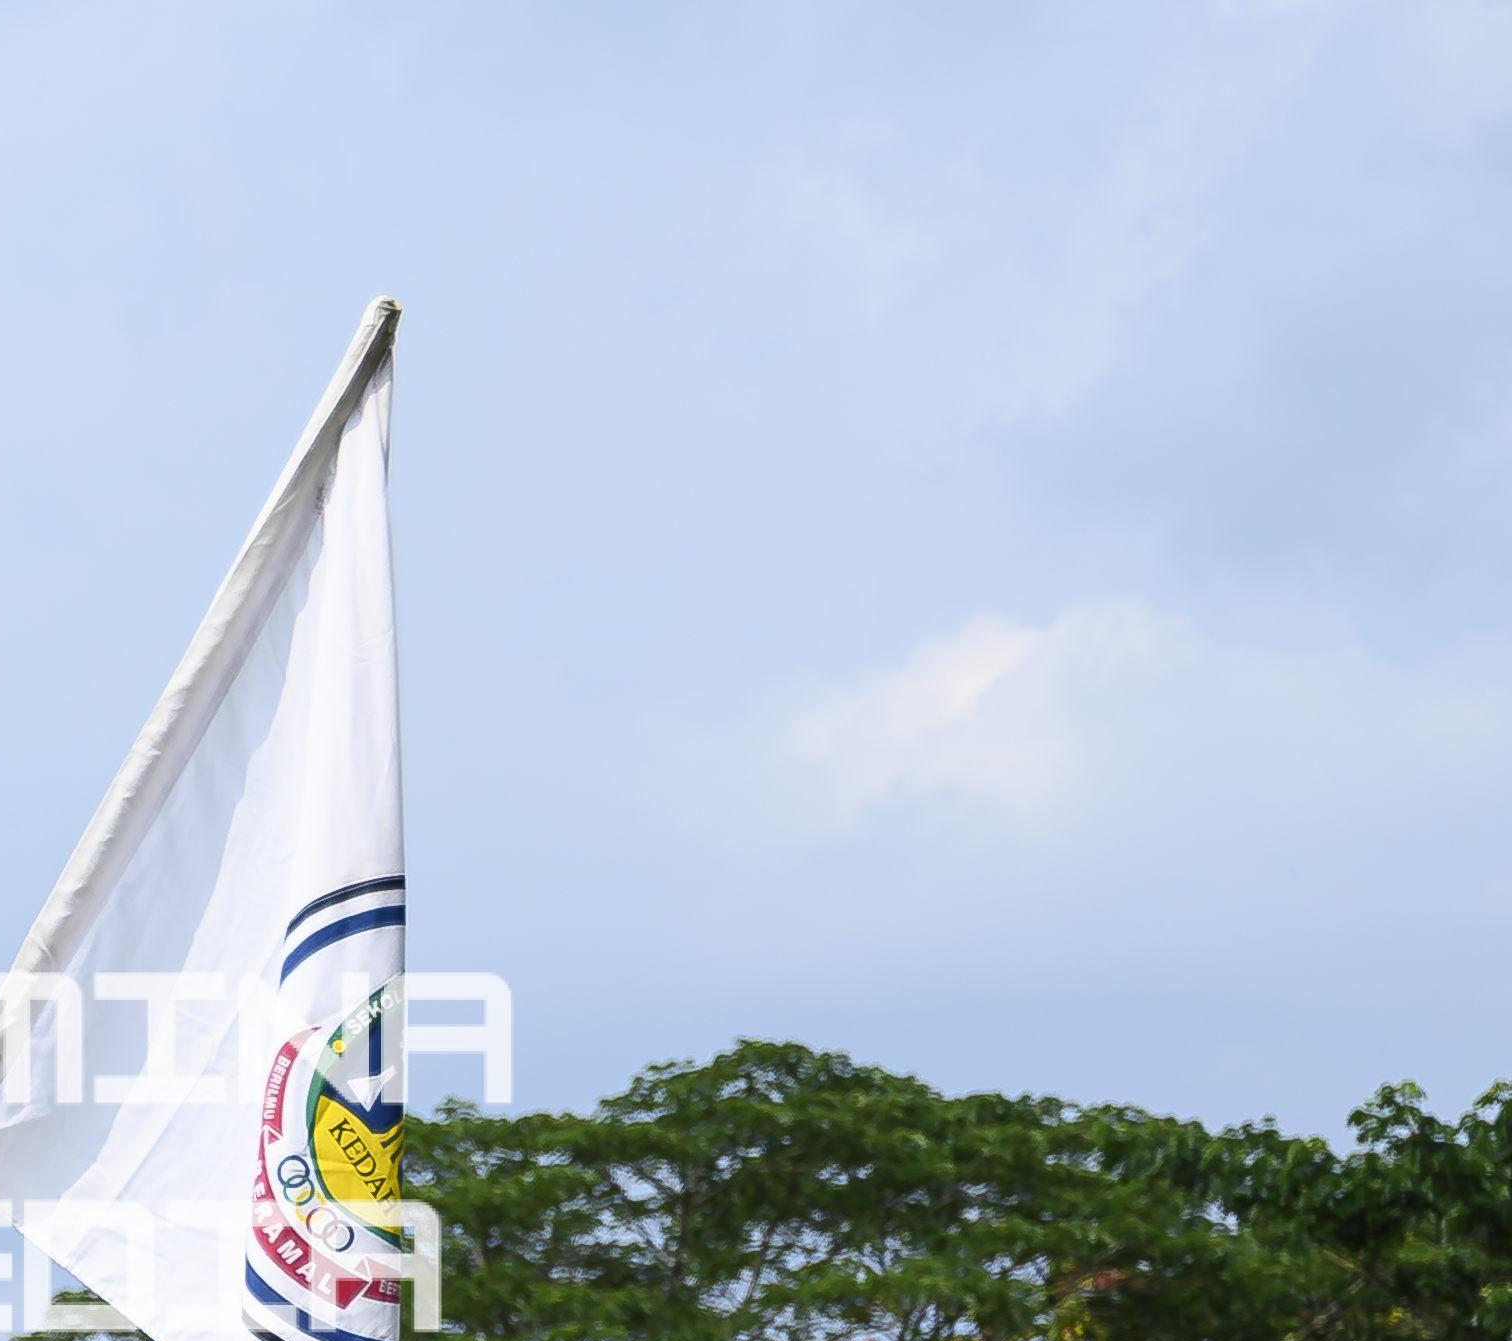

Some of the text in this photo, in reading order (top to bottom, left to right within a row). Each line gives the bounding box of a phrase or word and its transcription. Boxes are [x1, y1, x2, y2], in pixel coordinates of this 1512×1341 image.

[263, 1054, 292, 1121] BERILMU
[328, 1117, 398, 1218] KEDAH
[253, 1165, 333, 1296] ERAMAL
